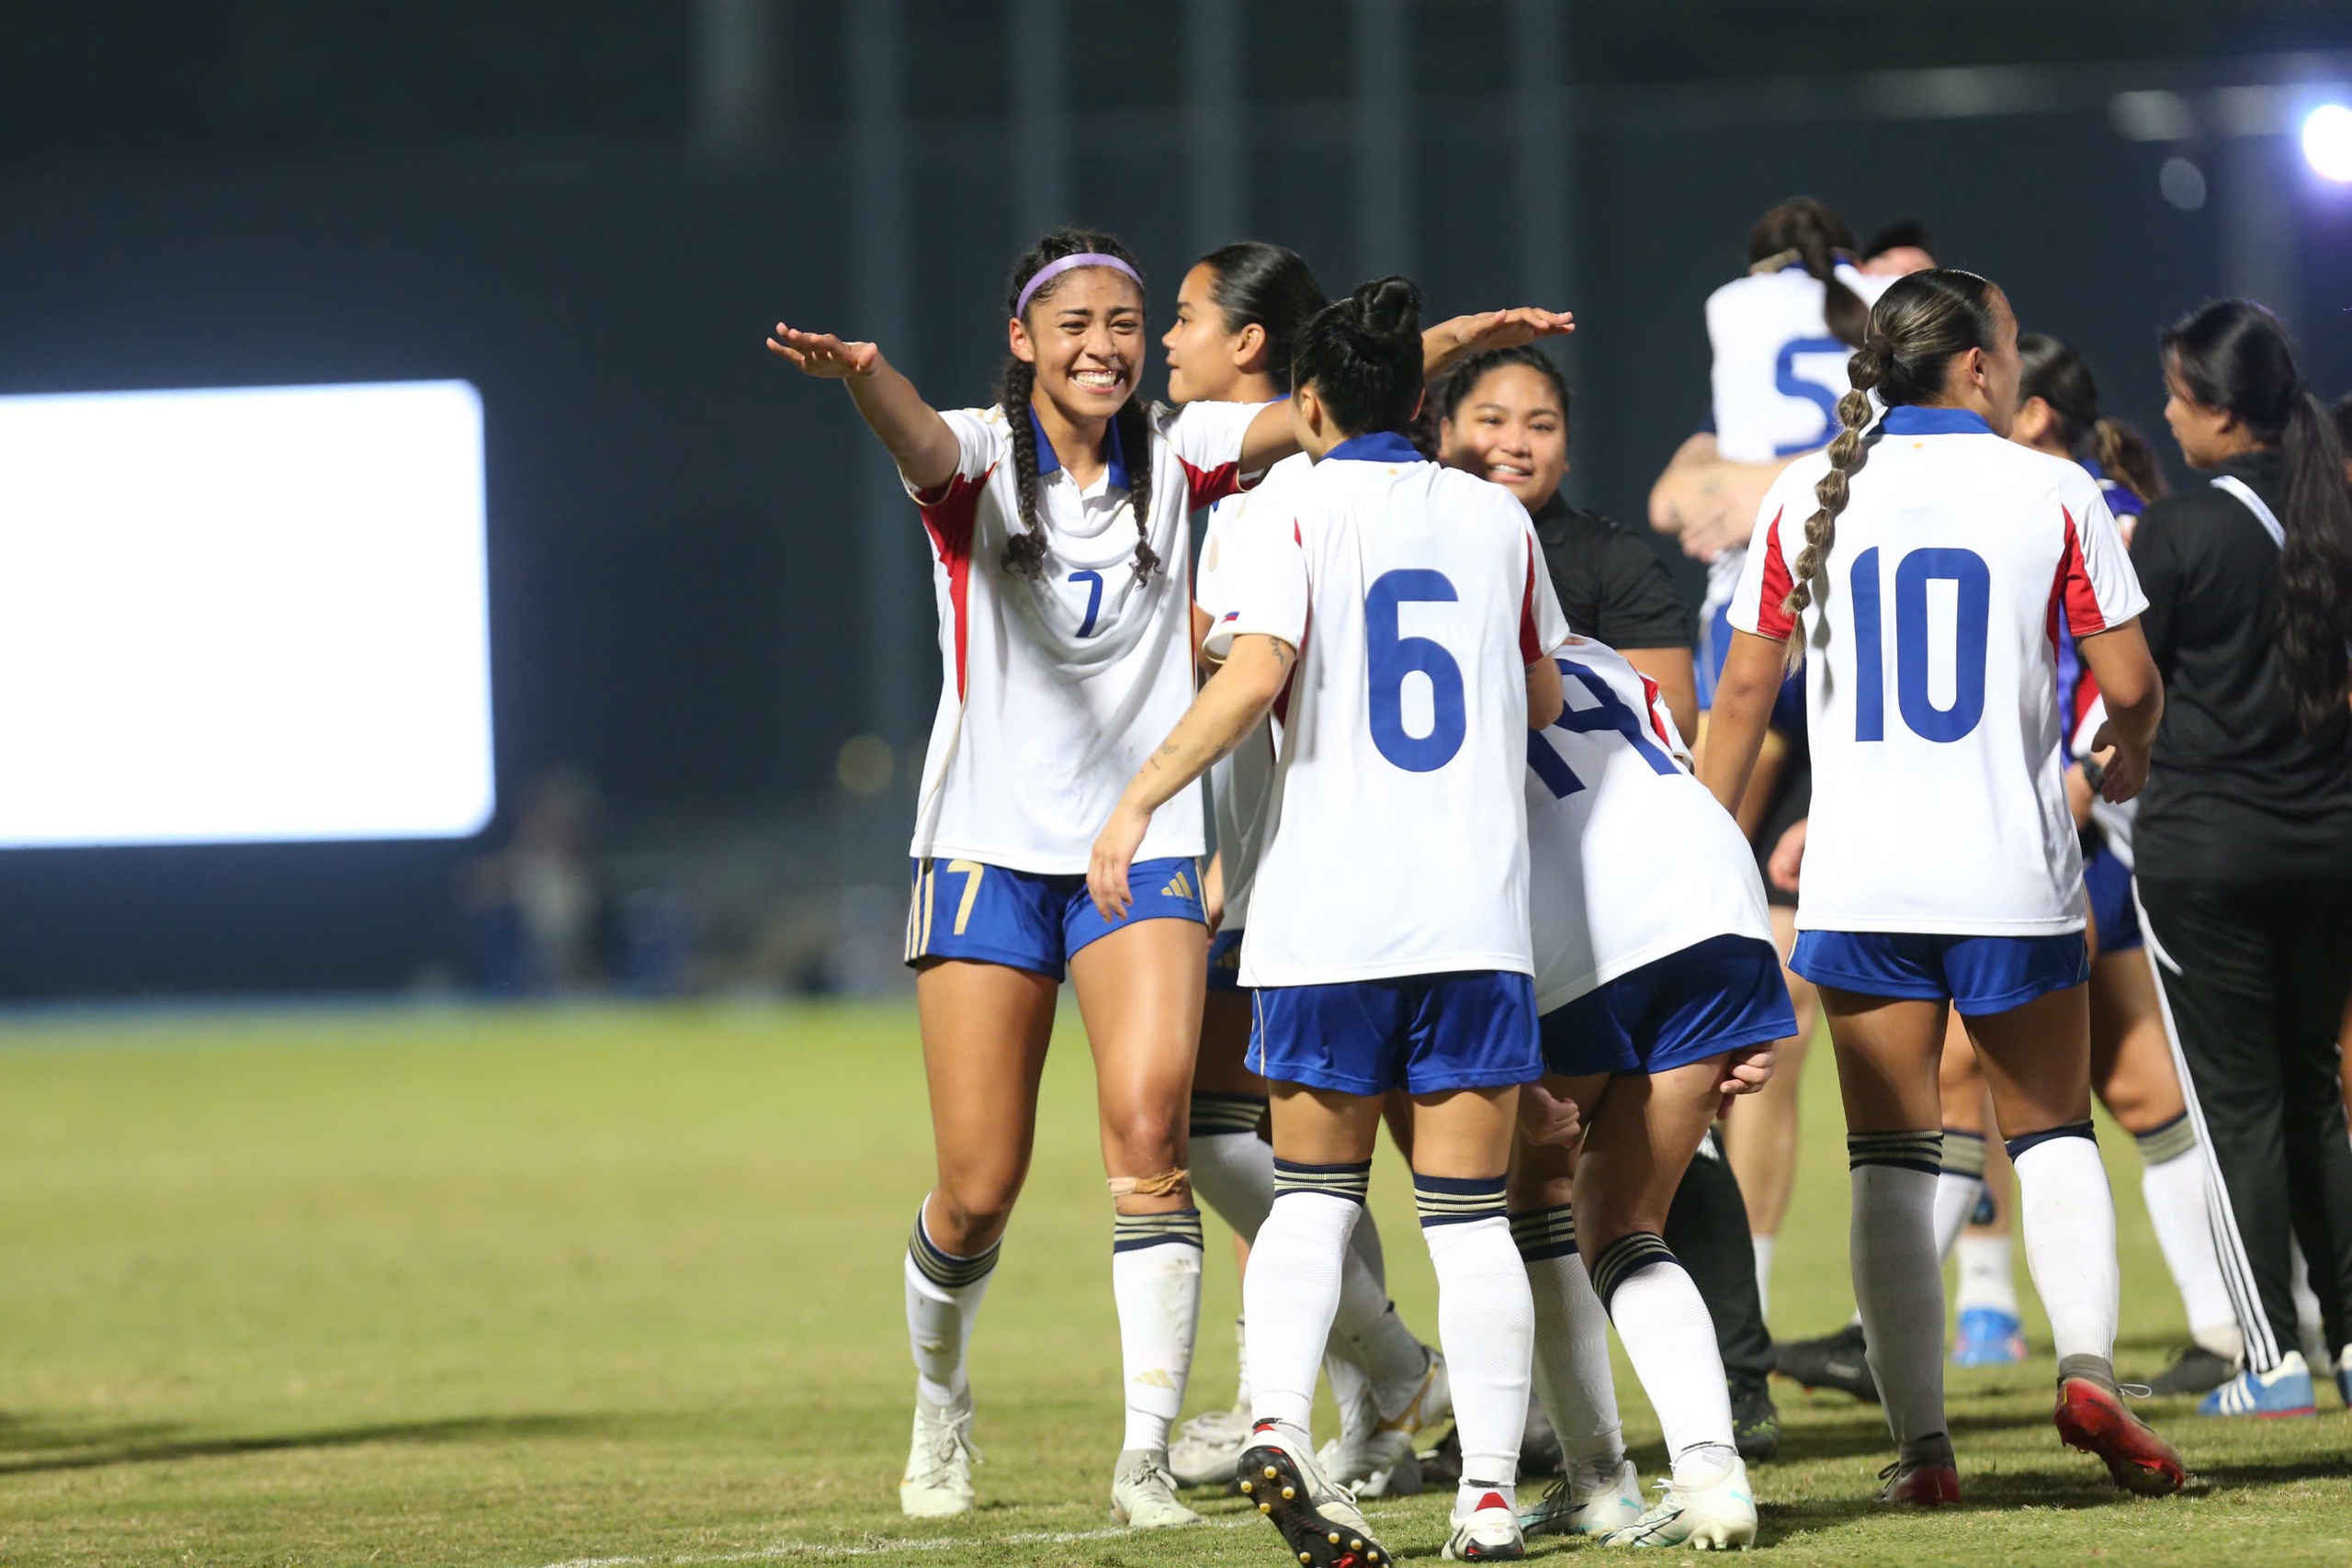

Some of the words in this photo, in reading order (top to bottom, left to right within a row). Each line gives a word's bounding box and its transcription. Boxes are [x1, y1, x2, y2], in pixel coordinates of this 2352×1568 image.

[1775, 337, 1846, 457] 5
[1068, 570, 1103, 637] 7
[1850, 547, 1990, 743] 10
[1365, 569, 1466, 773] 6
[946, 859, 984, 936] 7
